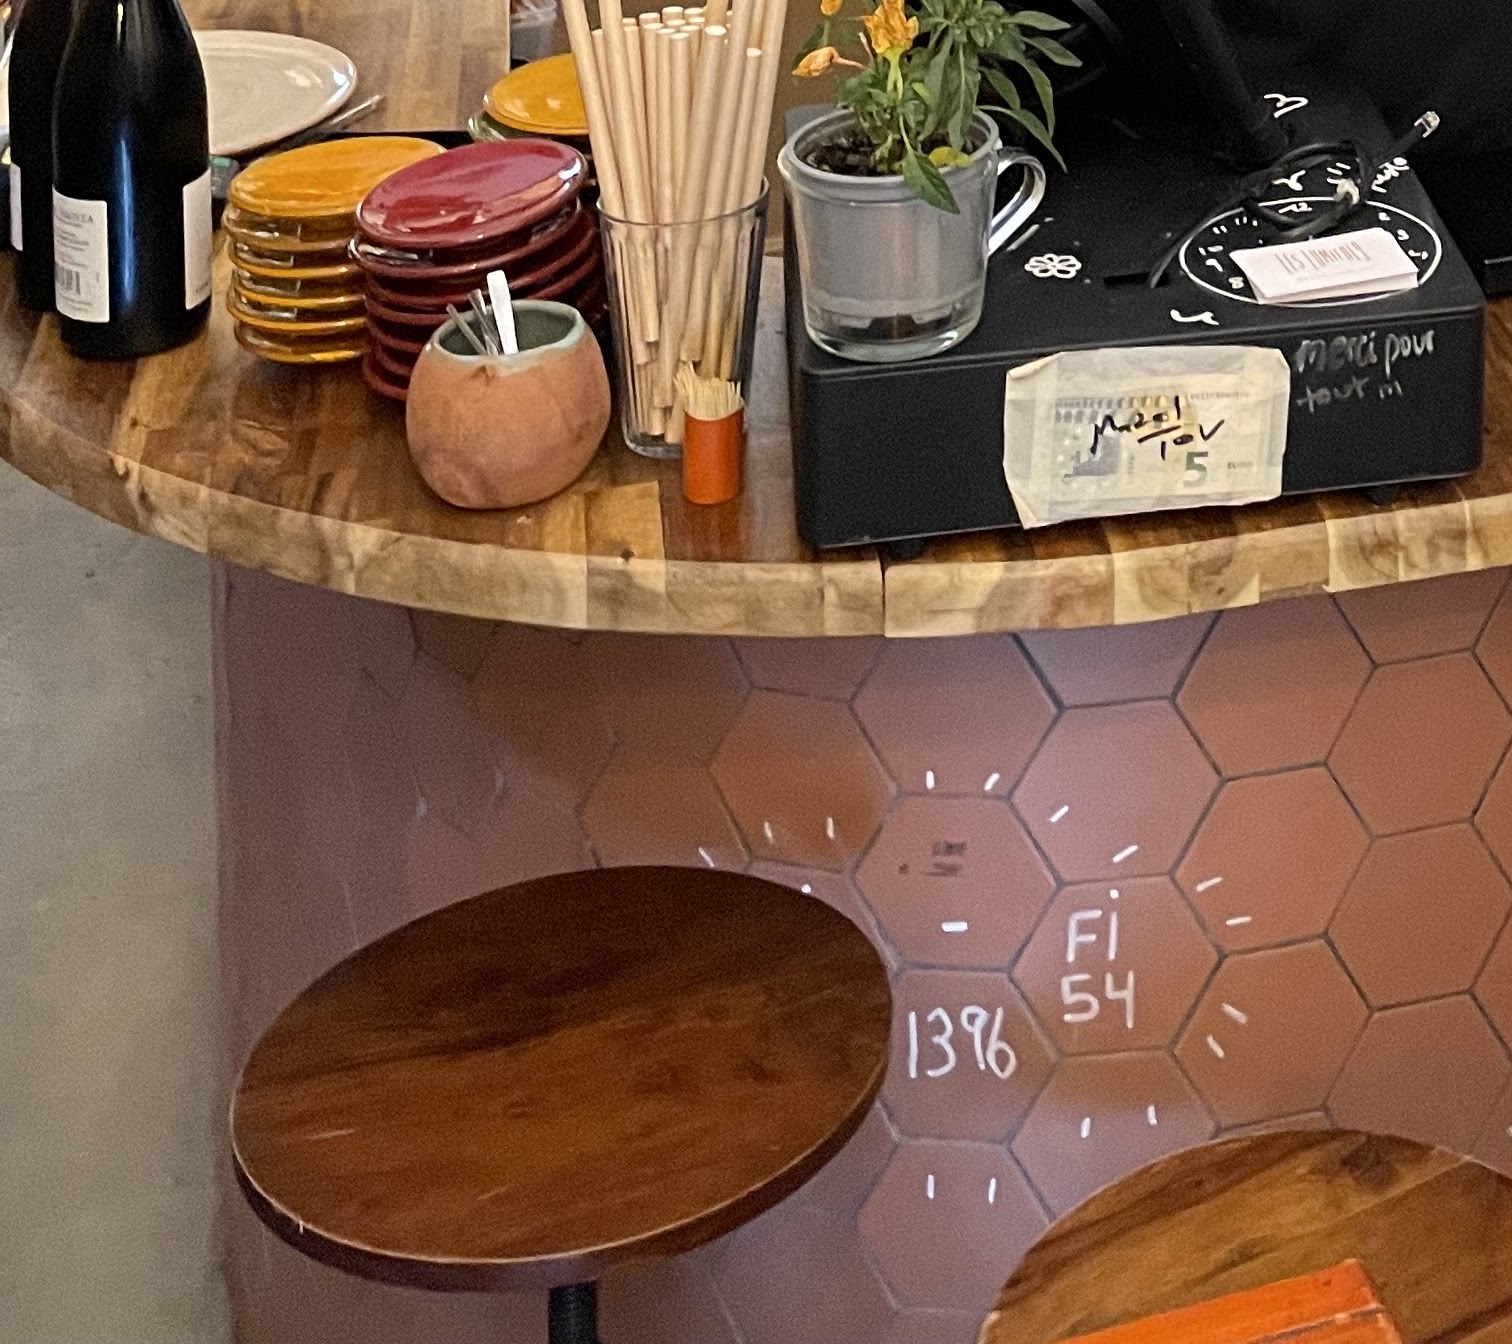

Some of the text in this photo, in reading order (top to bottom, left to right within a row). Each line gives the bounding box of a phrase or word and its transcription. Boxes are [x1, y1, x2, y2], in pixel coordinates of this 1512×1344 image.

[1385, 330, 1435, 380] pour
[1061, 970, 1135, 1028] 54
[908, 1006, 1017, 1078] 1396
